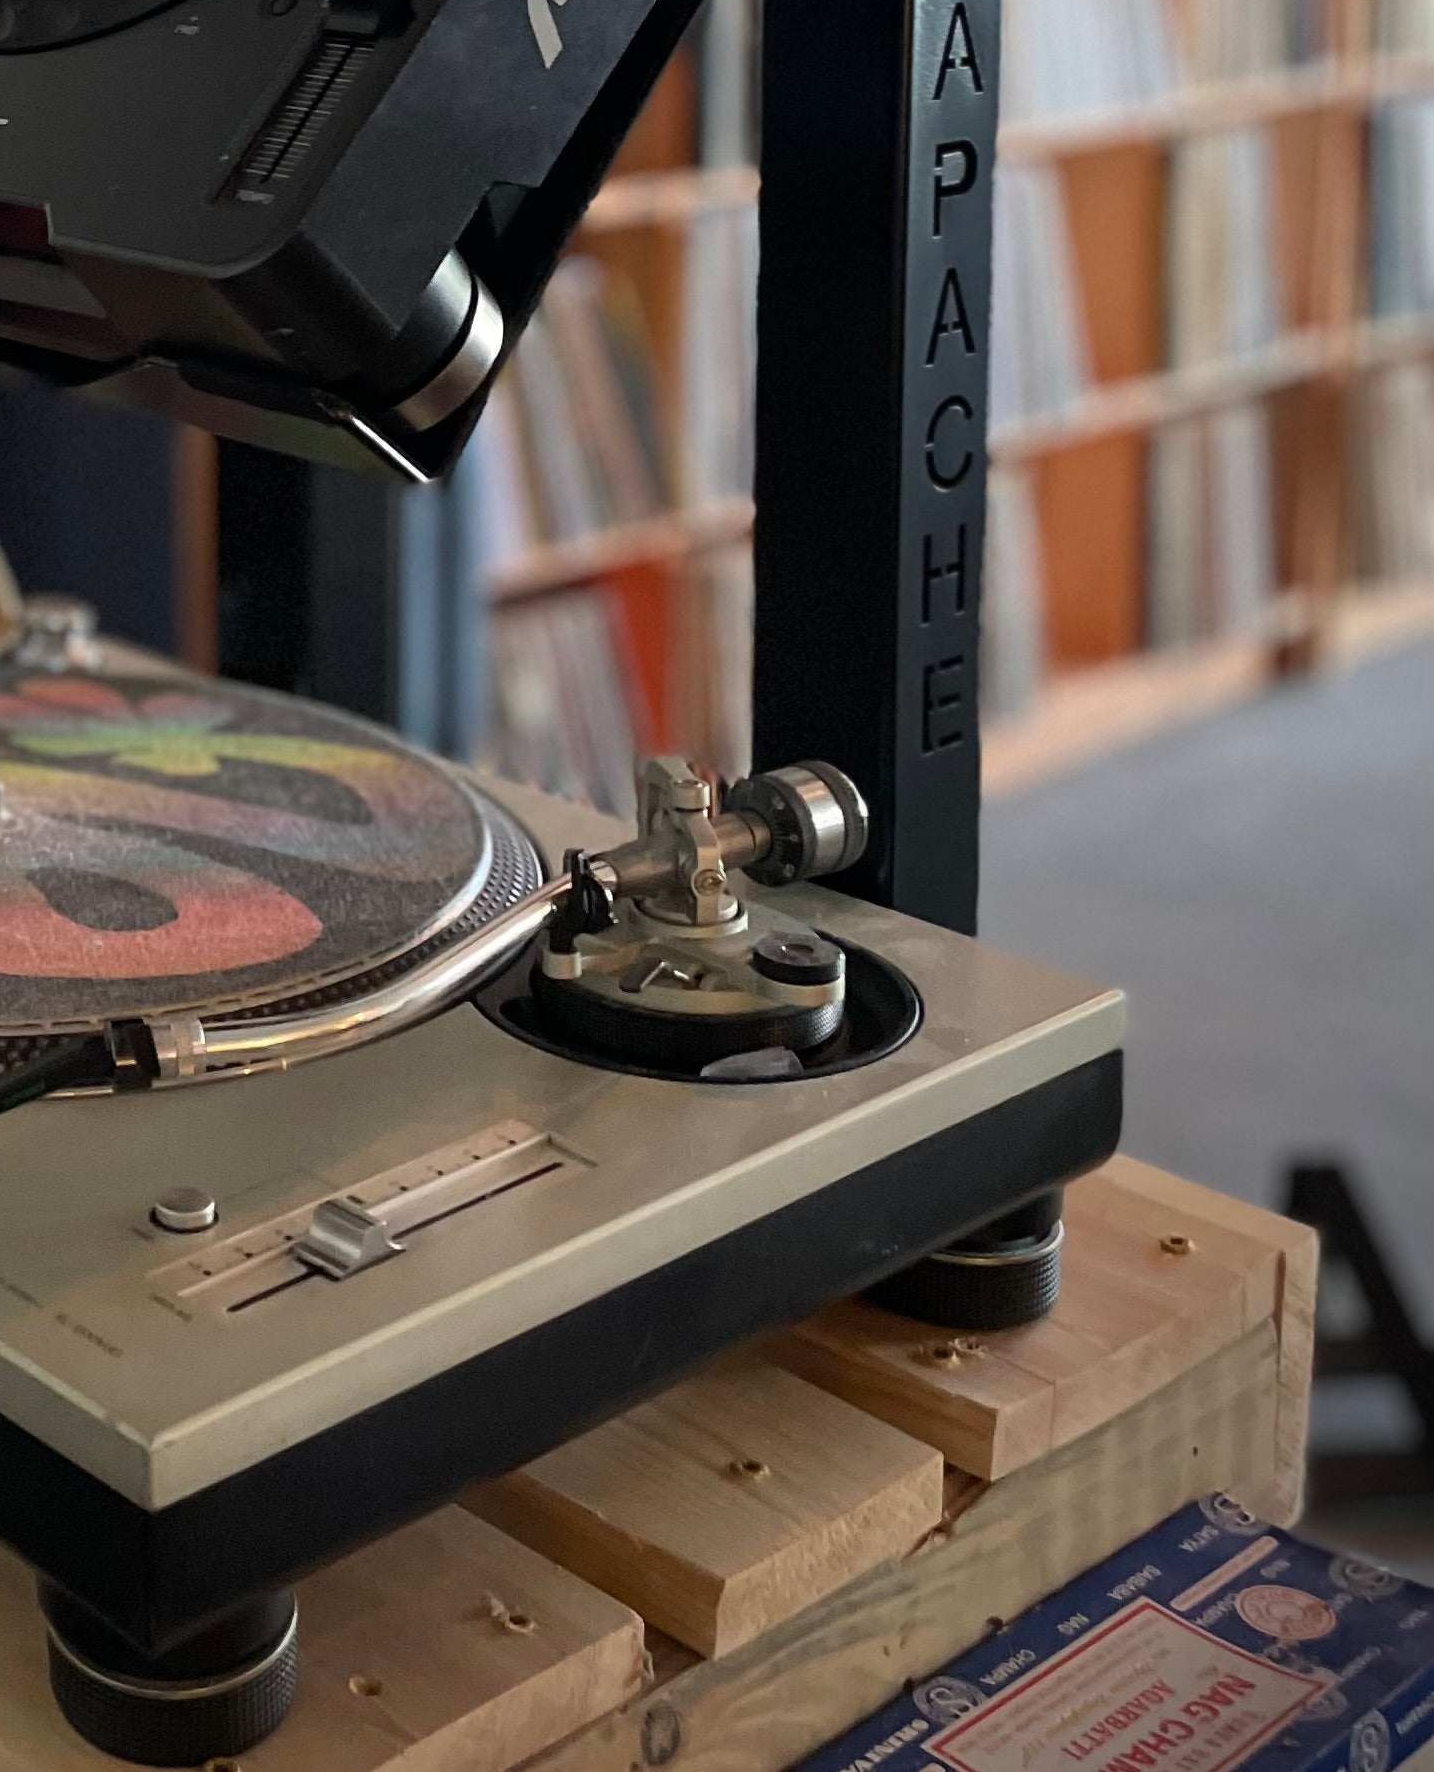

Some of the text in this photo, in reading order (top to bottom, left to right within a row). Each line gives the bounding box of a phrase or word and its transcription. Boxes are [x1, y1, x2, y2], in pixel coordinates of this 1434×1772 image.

[919, 1, 984, 757] APACHE
[979, 1648, 1036, 1686] CHAMPA
[1181, 1672, 1256, 1719] NAG
